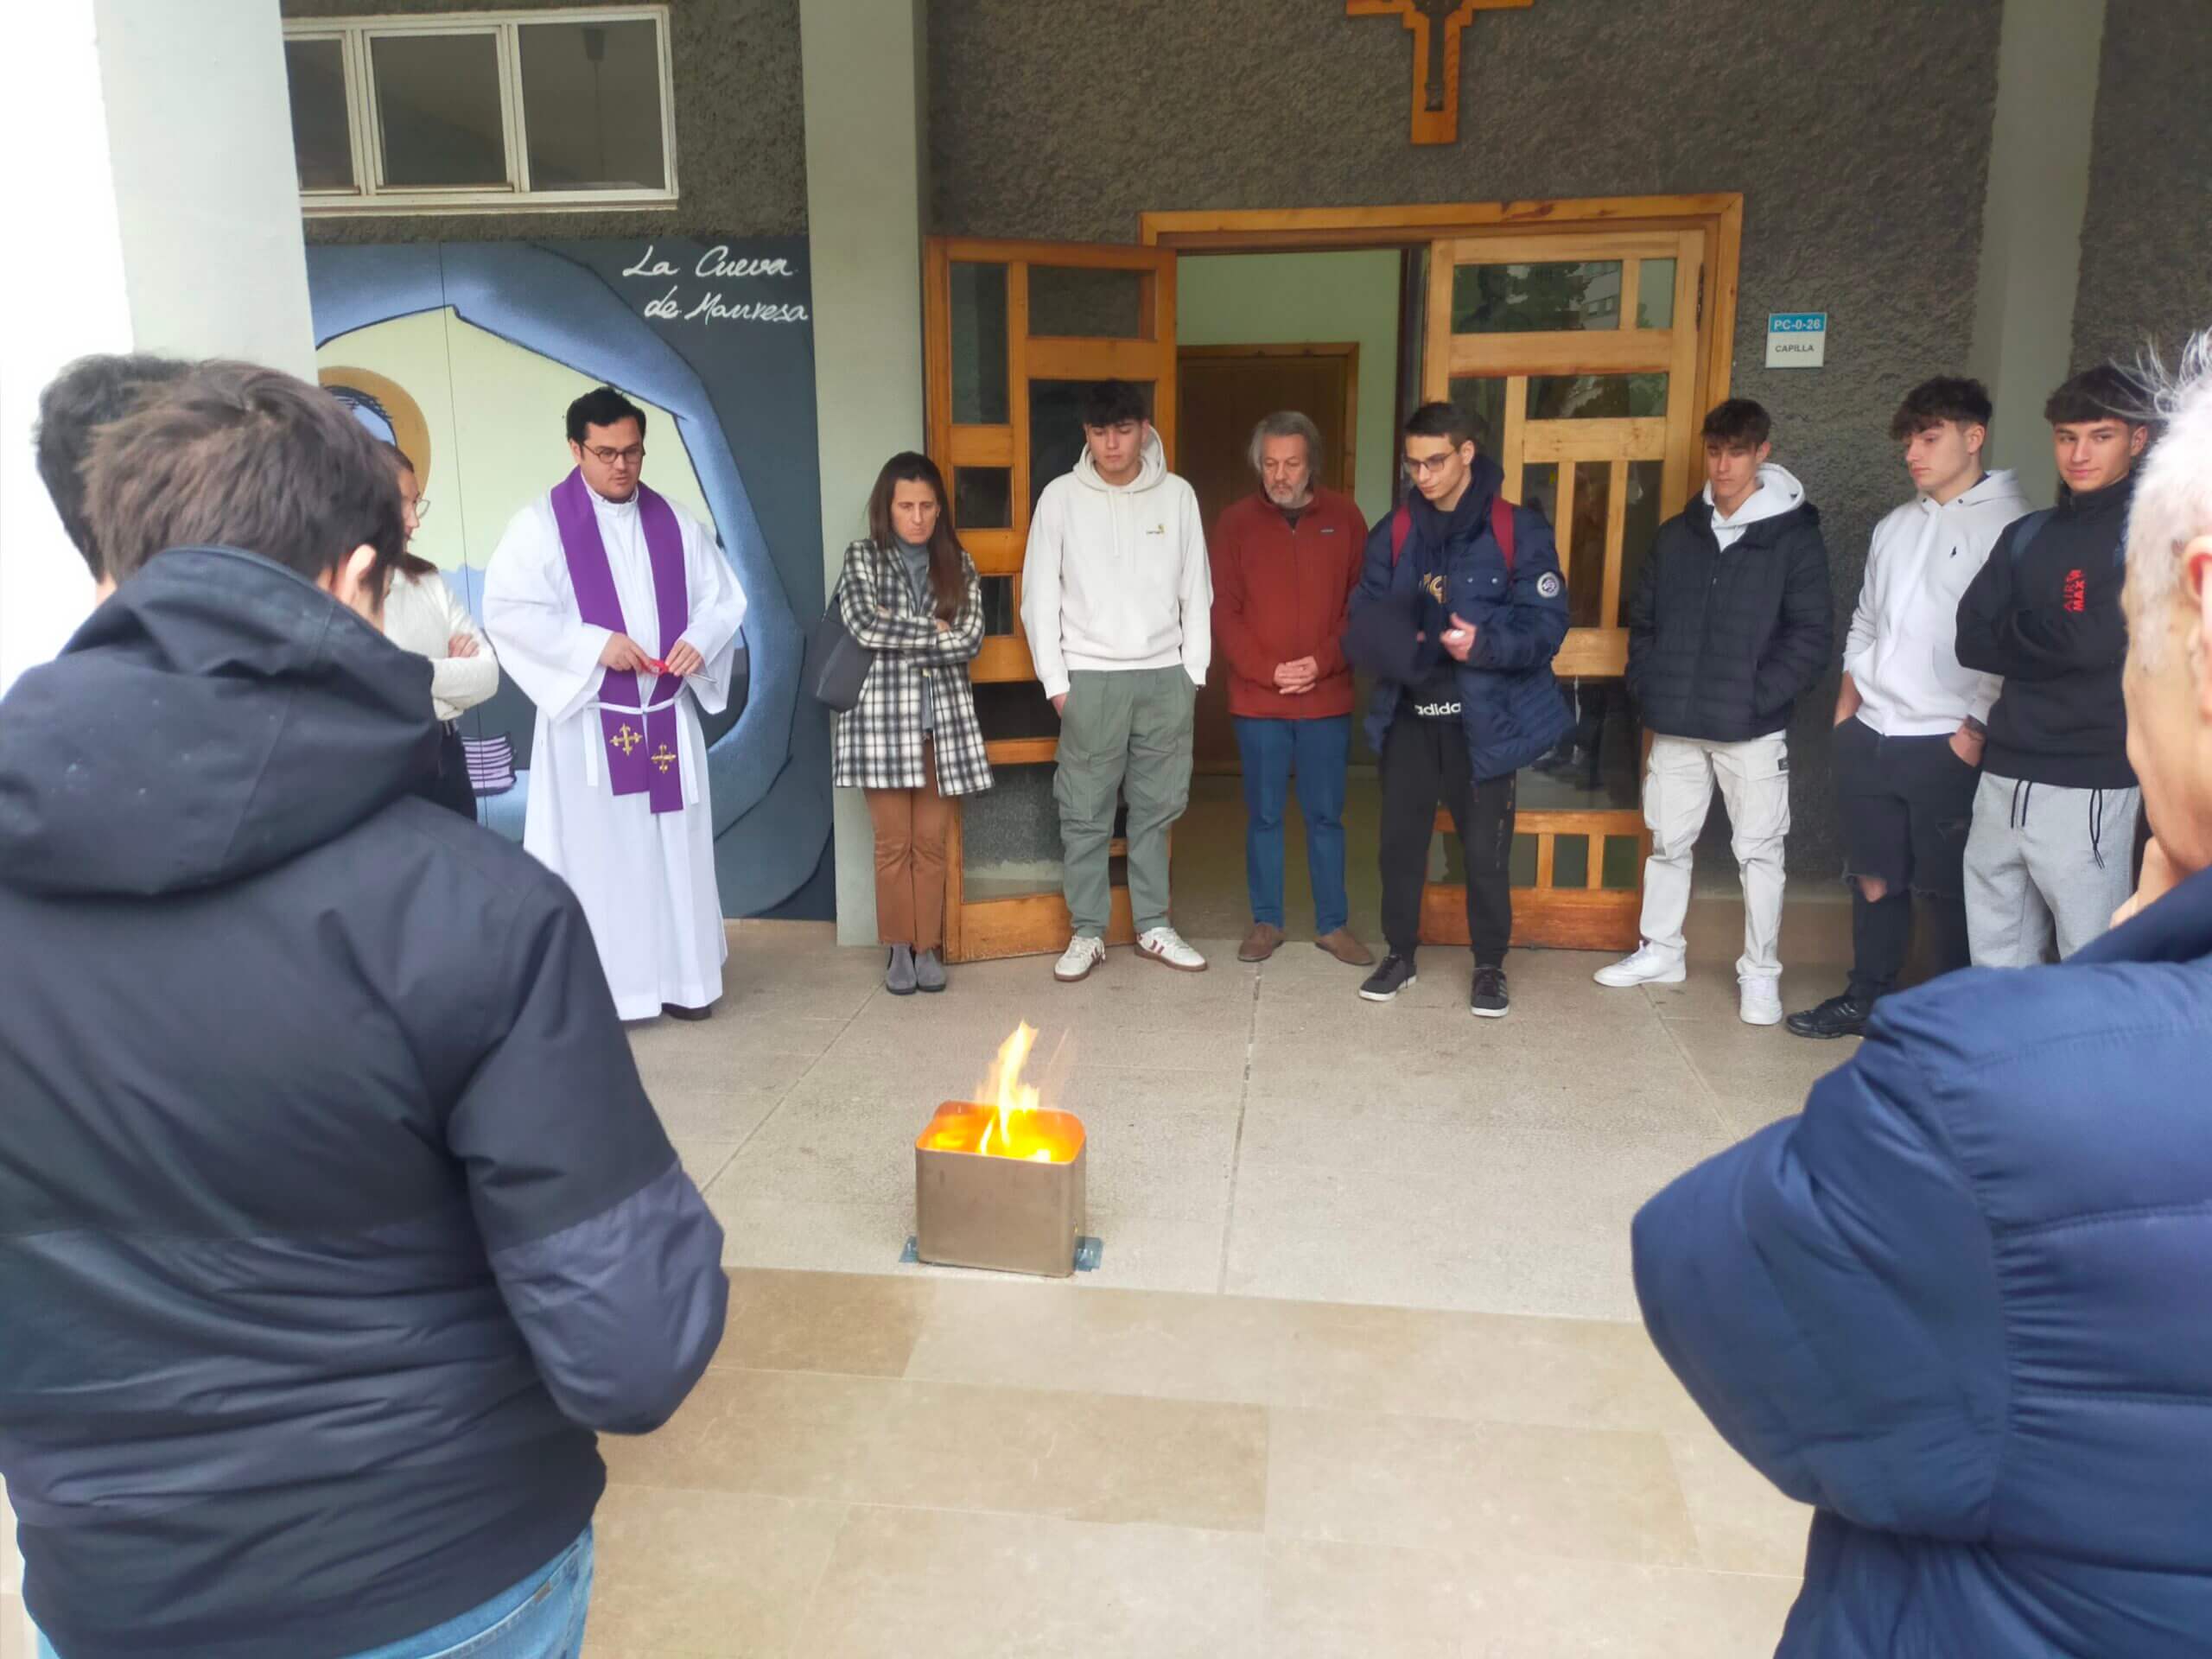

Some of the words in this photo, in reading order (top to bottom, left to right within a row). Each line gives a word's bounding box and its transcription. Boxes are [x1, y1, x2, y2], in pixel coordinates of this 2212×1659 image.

[622, 245, 680, 276] La
[695, 245, 795, 277] Cueva
[644, 284, 680, 319] de
[1774, 319, 1821, 330] PC-0-26
[1414, 701, 1461, 716] adida
